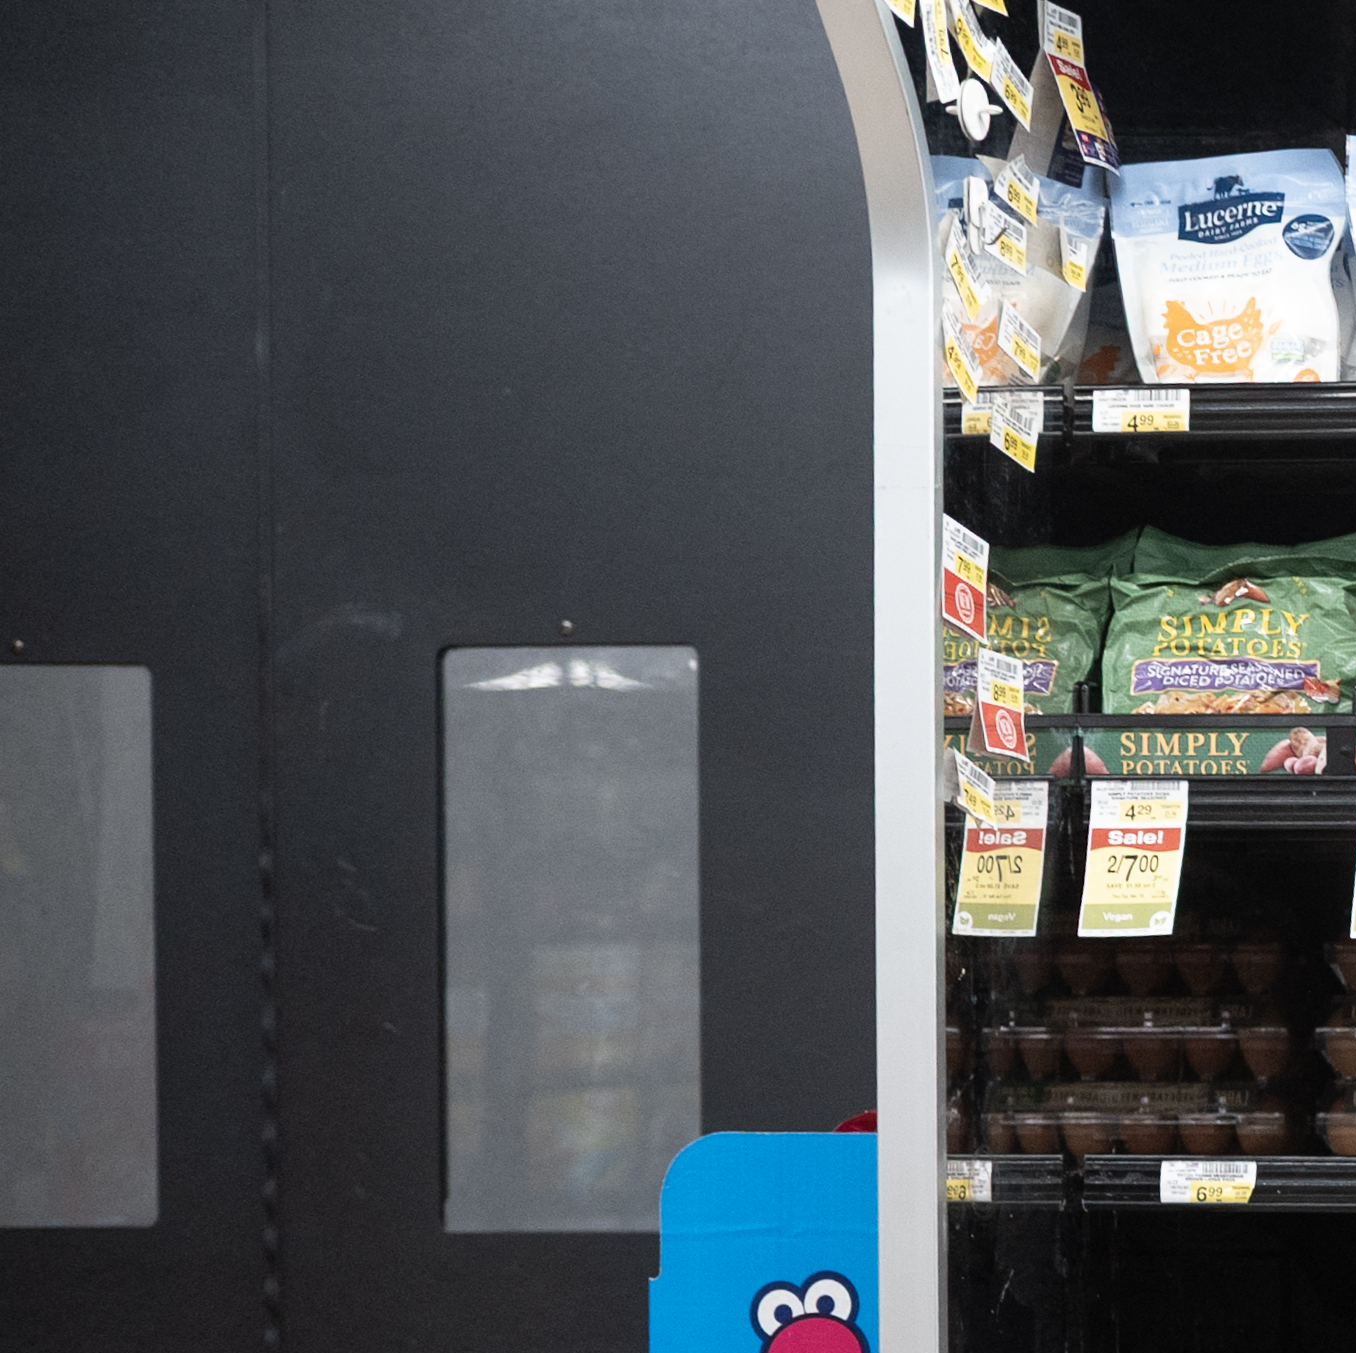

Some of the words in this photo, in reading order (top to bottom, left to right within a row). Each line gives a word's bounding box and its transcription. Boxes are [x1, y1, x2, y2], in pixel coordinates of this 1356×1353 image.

[1185, 201, 1277, 231] Lucerne
[1198, 227, 1226, 238] DAIRY
[1230, 217, 1258, 230] FARMS
[1176, 324, 1243, 349] Cage
[1193, 342, 1252, 366] Free
[1158, 608, 1309, 641] SIMPLY
[1152, 638, 1302, 657] POTATOES
[1148, 664, 1227, 678] SIGNATURE
[1163, 676, 1211, 686] DICED
[1215, 674, 1285, 687] POTATOES
[1120, 732, 1250, 757] SIMPLY
[1122, 760, 1248, 775] POTATOES
[1107, 830, 1164, 845] Sale!
[1102, 912, 1133, 922] Vegan
